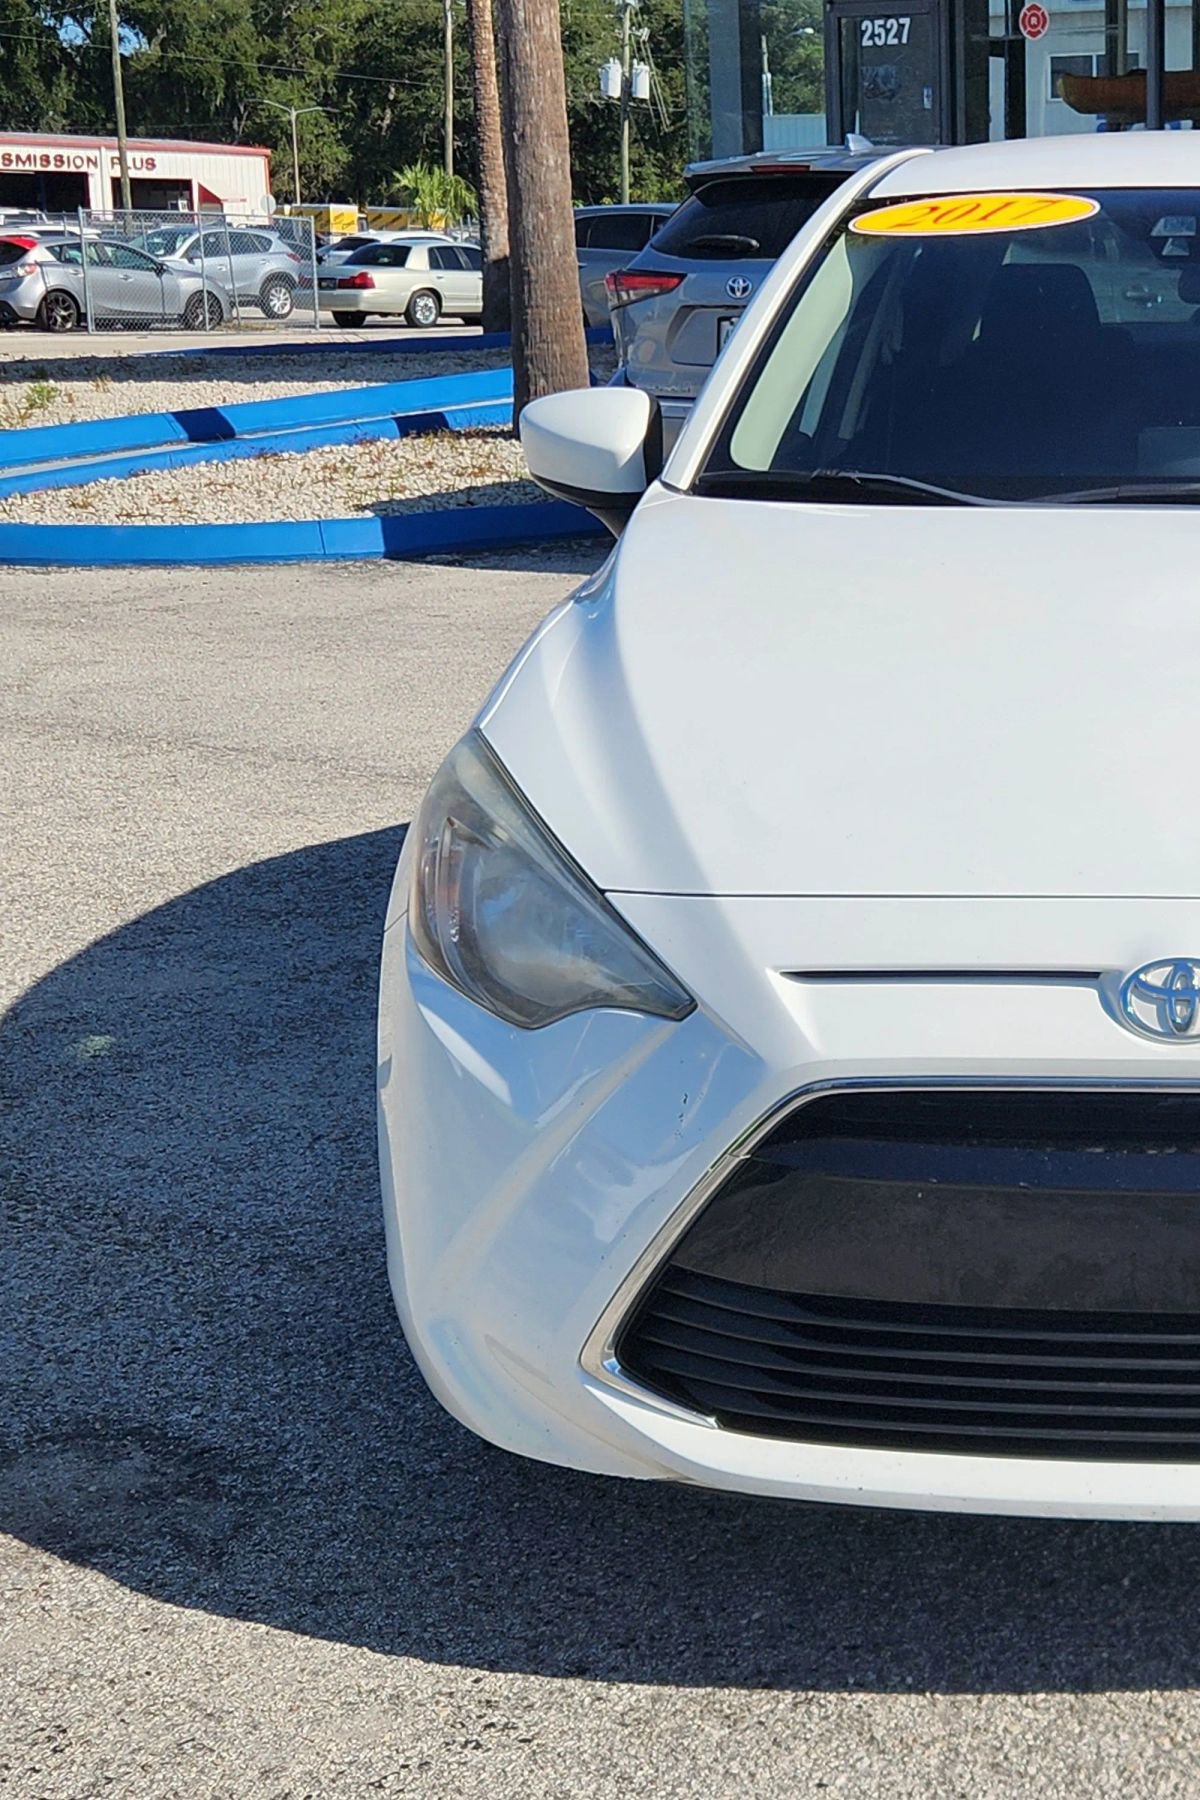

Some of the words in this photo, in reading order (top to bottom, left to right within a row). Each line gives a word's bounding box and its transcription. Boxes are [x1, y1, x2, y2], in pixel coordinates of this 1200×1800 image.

[861, 17, 911, 46] 2527
[1, 153, 98, 169] SMISSION
[111, 157, 157, 170] PUS
[887, 199, 1063, 228] 2017
